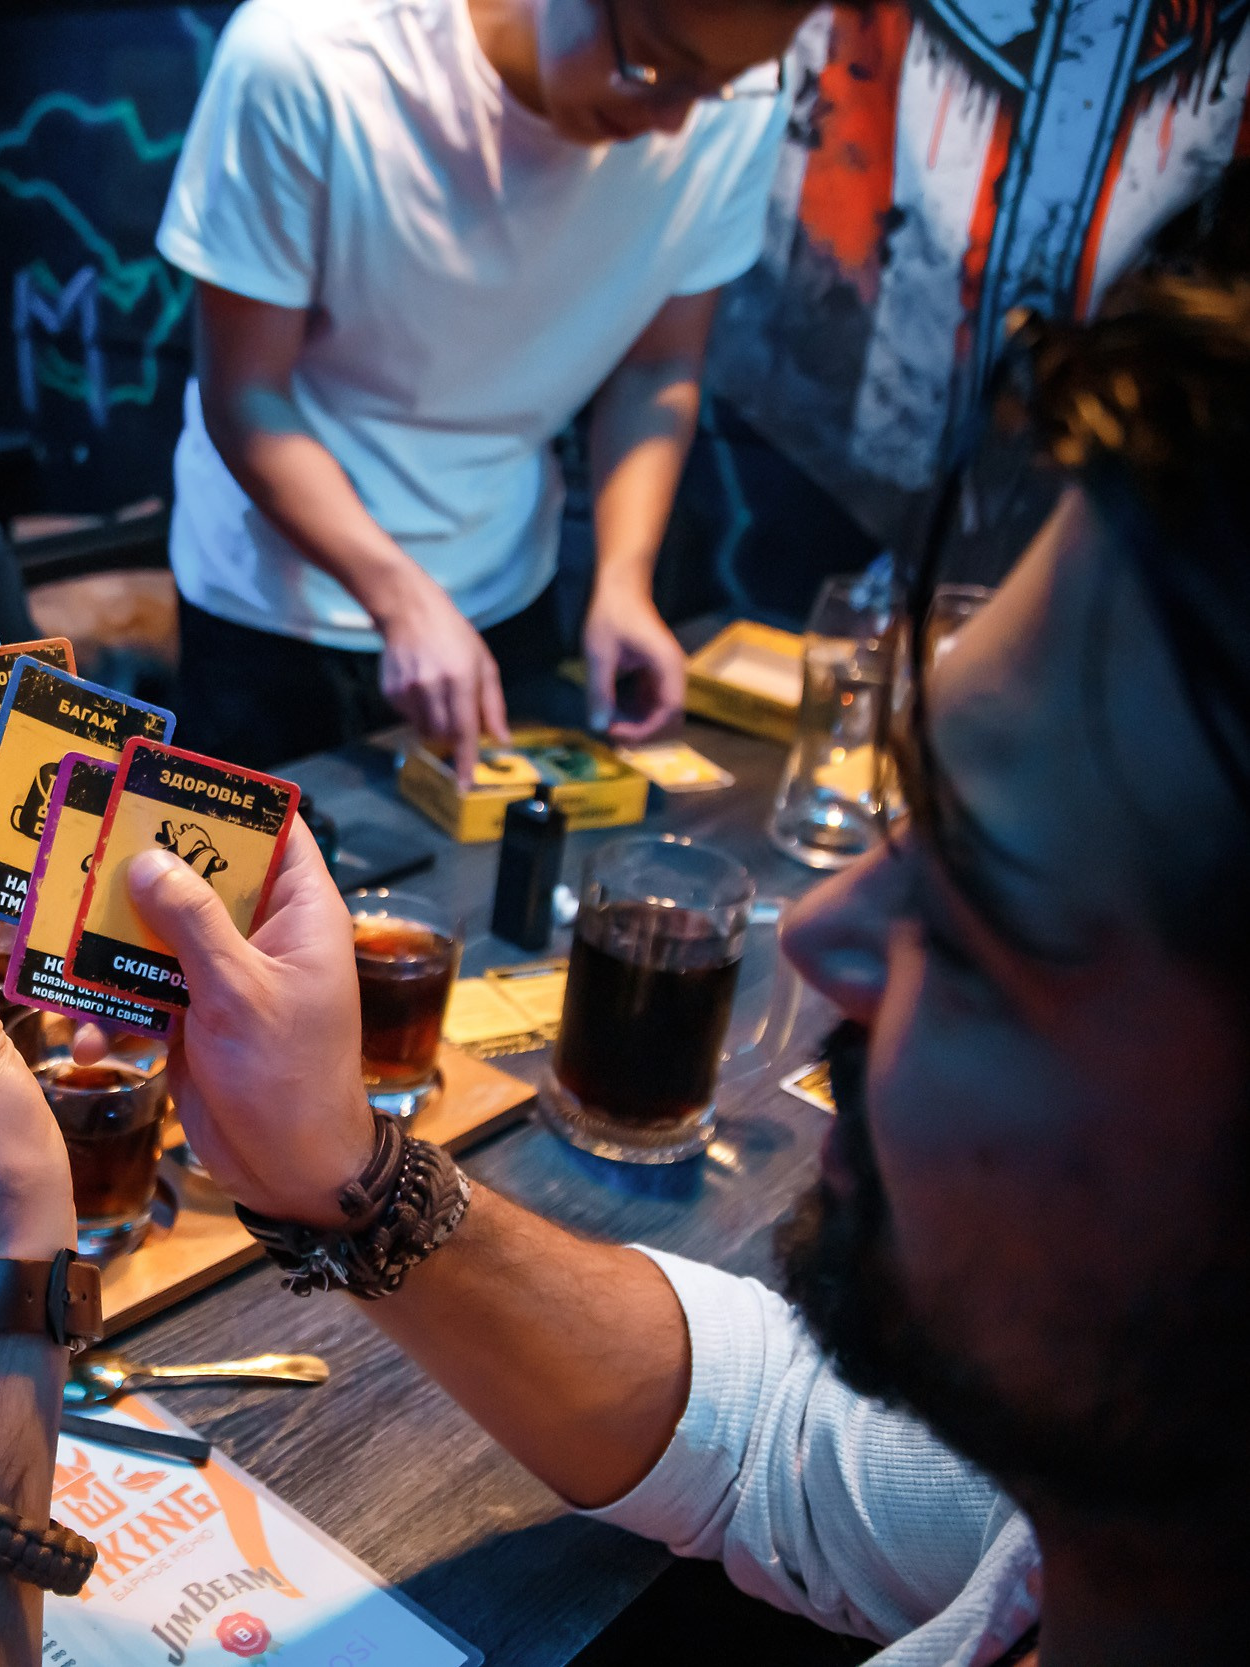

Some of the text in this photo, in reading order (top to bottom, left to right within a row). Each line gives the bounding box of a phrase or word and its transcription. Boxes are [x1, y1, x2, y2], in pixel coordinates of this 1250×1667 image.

[58, 699, 118, 733] БАГАЖ
[160, 770, 256, 810] ЗДОРОВЬЕ
[5, 875, 27, 894] НА
[32, 971, 75, 991] БОЯЗНЬ
[31, 986, 153, 1026] МОБИЛЬНОГО И СВЯЗИ
[111, 1529, 215, 1601] БАРНОЕ МЕНЮ
[182, 1566, 284, 1613] BEAM
